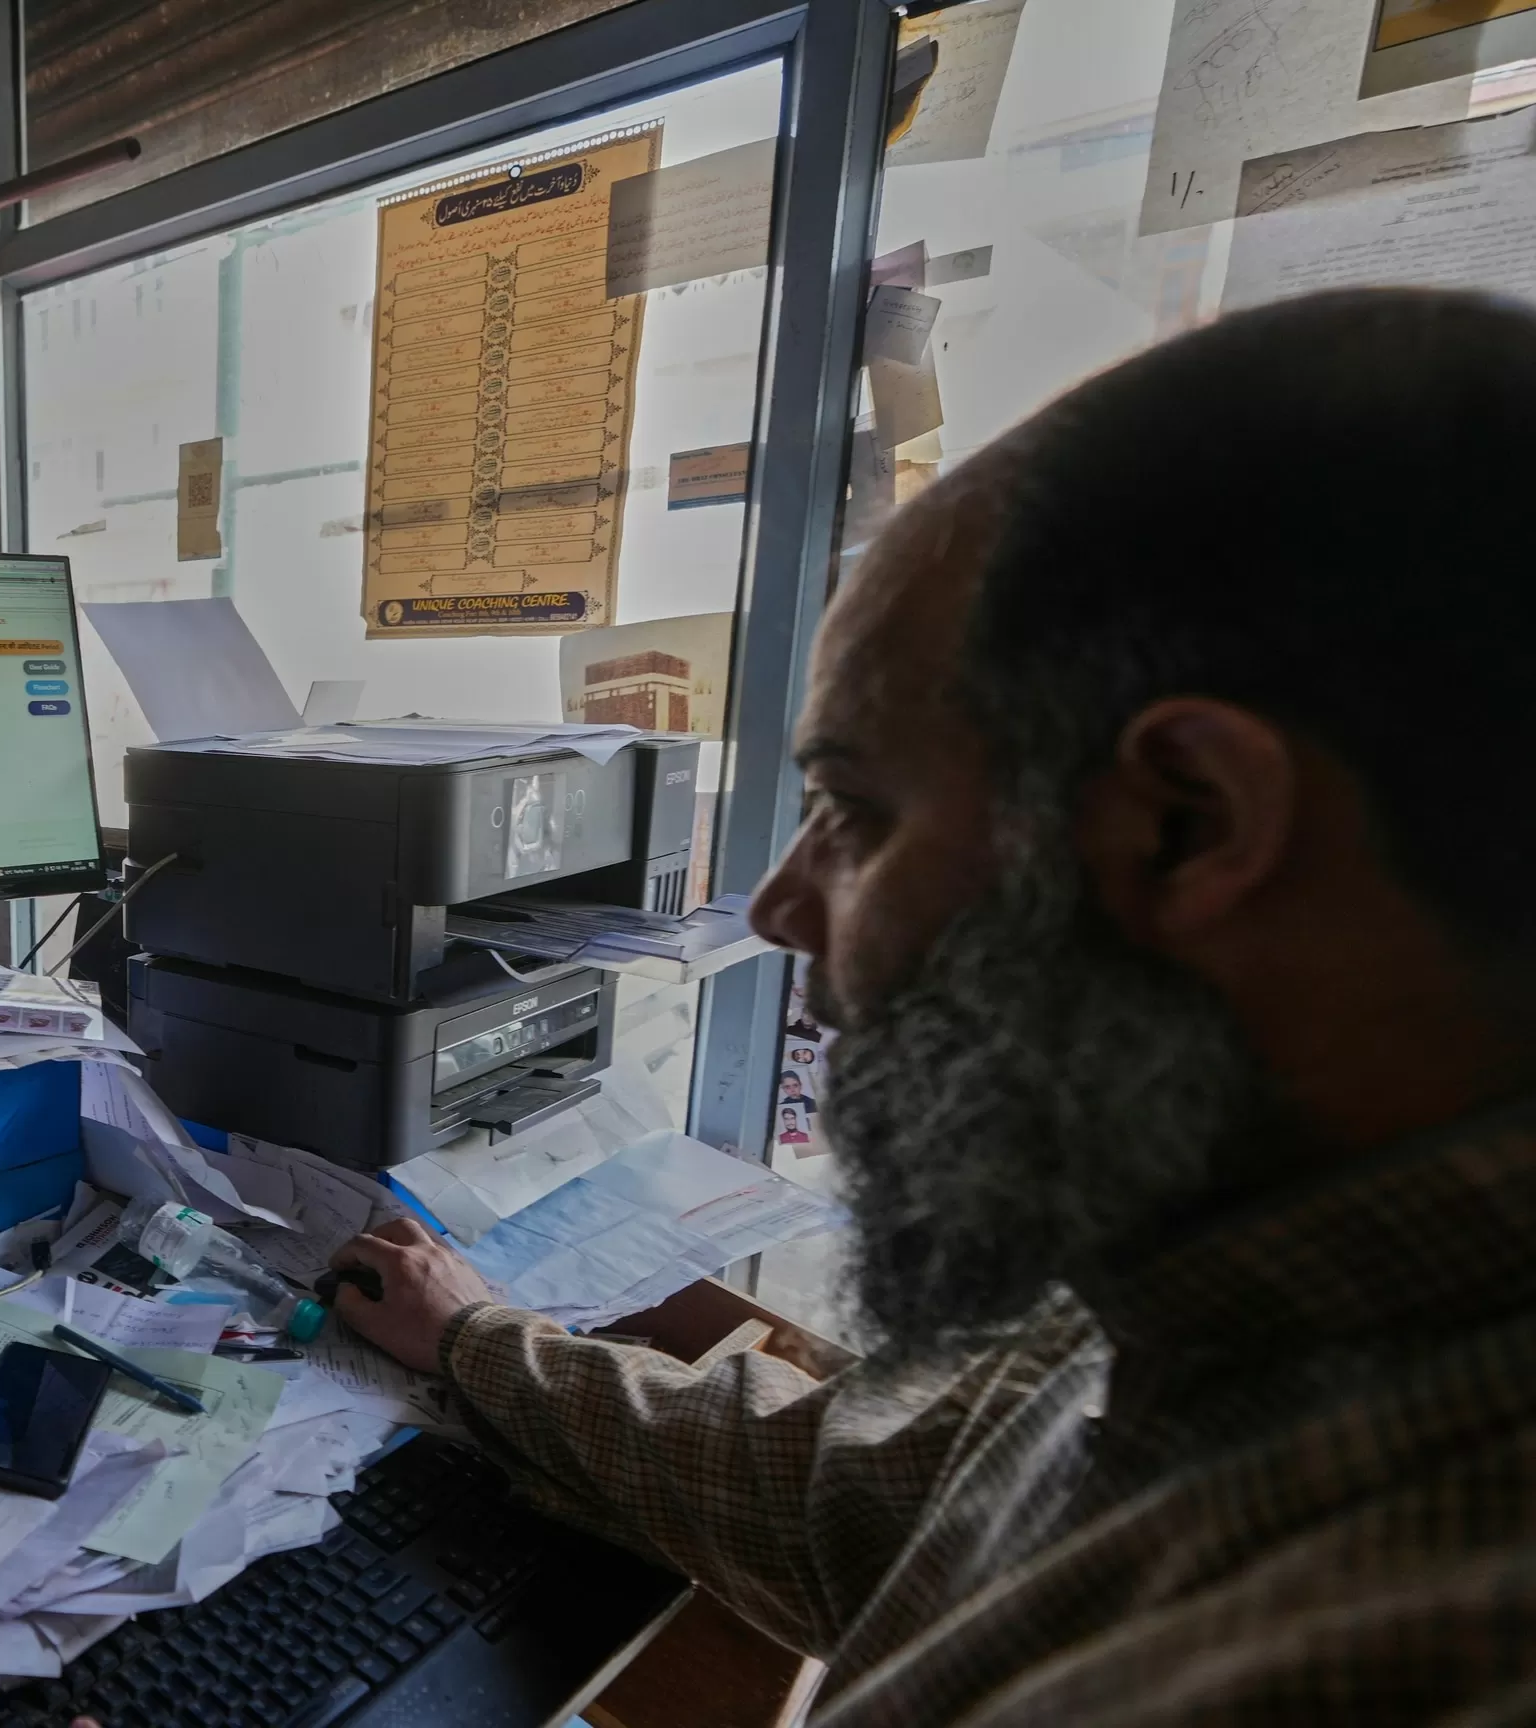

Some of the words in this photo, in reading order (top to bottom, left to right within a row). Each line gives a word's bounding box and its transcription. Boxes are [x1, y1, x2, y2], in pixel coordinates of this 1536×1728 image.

[413, 599, 454, 611] UNIQUE
[457, 595, 519, 610] COACHING
[512, 996, 539, 1015] EPSON
[82, 1214, 118, 1246] JOHNSON
